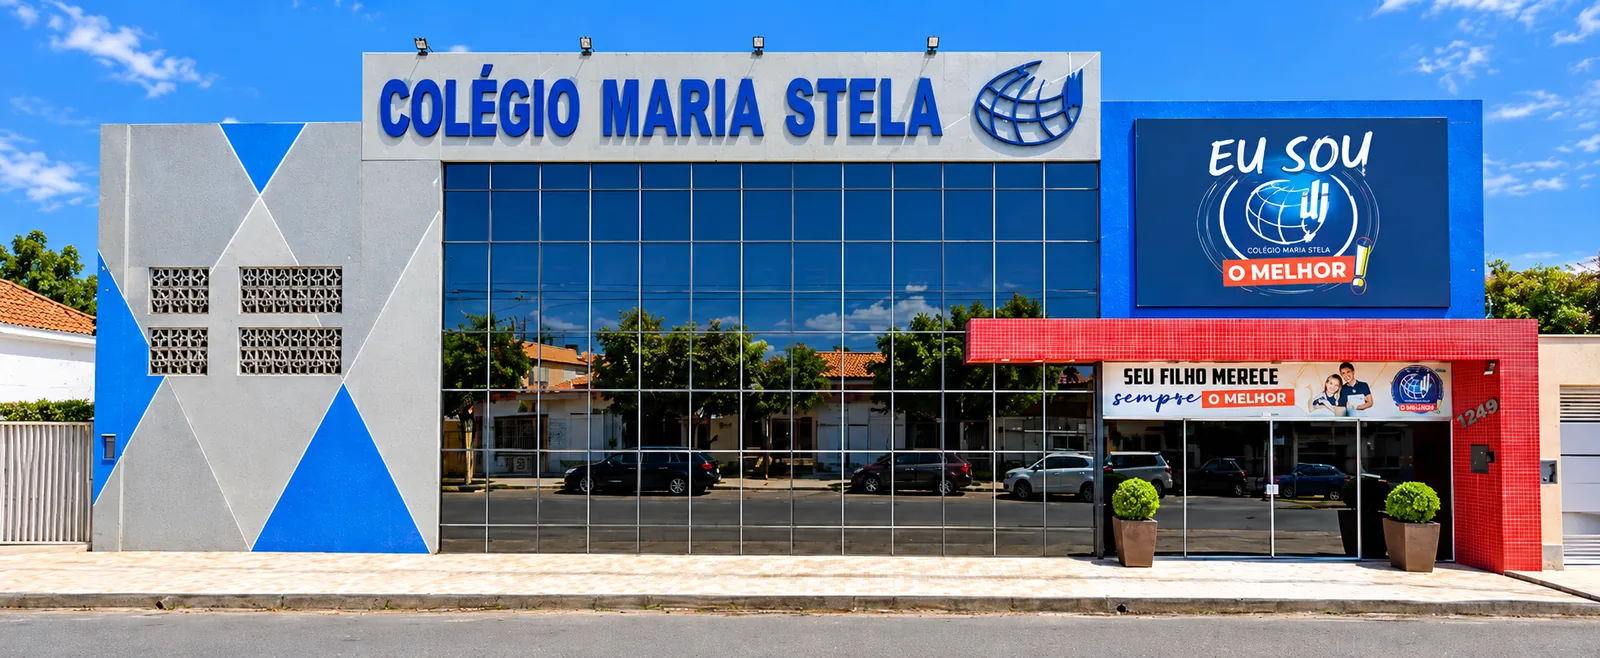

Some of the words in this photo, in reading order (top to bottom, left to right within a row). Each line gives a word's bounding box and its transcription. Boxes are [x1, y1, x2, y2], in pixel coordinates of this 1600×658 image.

[380, 64, 580, 137] COLÉGIO
[602, 78, 764, 137] MARIA
[785, 77, 943, 137] STELA
[1209, 137, 1266, 176] EU
[1281, 131, 1373, 177] SOU
[1247, 246, 1281, 254] COLÉGIO
[1308, 246, 1331, 254] STELA
[1228, 265, 1245, 281] O
[1251, 261, 1347, 281] MELHOR
[1124, 368, 1154, 385] SEU
[1160, 368, 1207, 385] FILHO
[1212, 368, 1279, 385] MERECE
[1113, 392, 1202, 412] sempre
[1208, 393, 1220, 405] O
[1224, 392, 1287, 405] MELHOR
[1457, 398, 1499, 428] 1249
